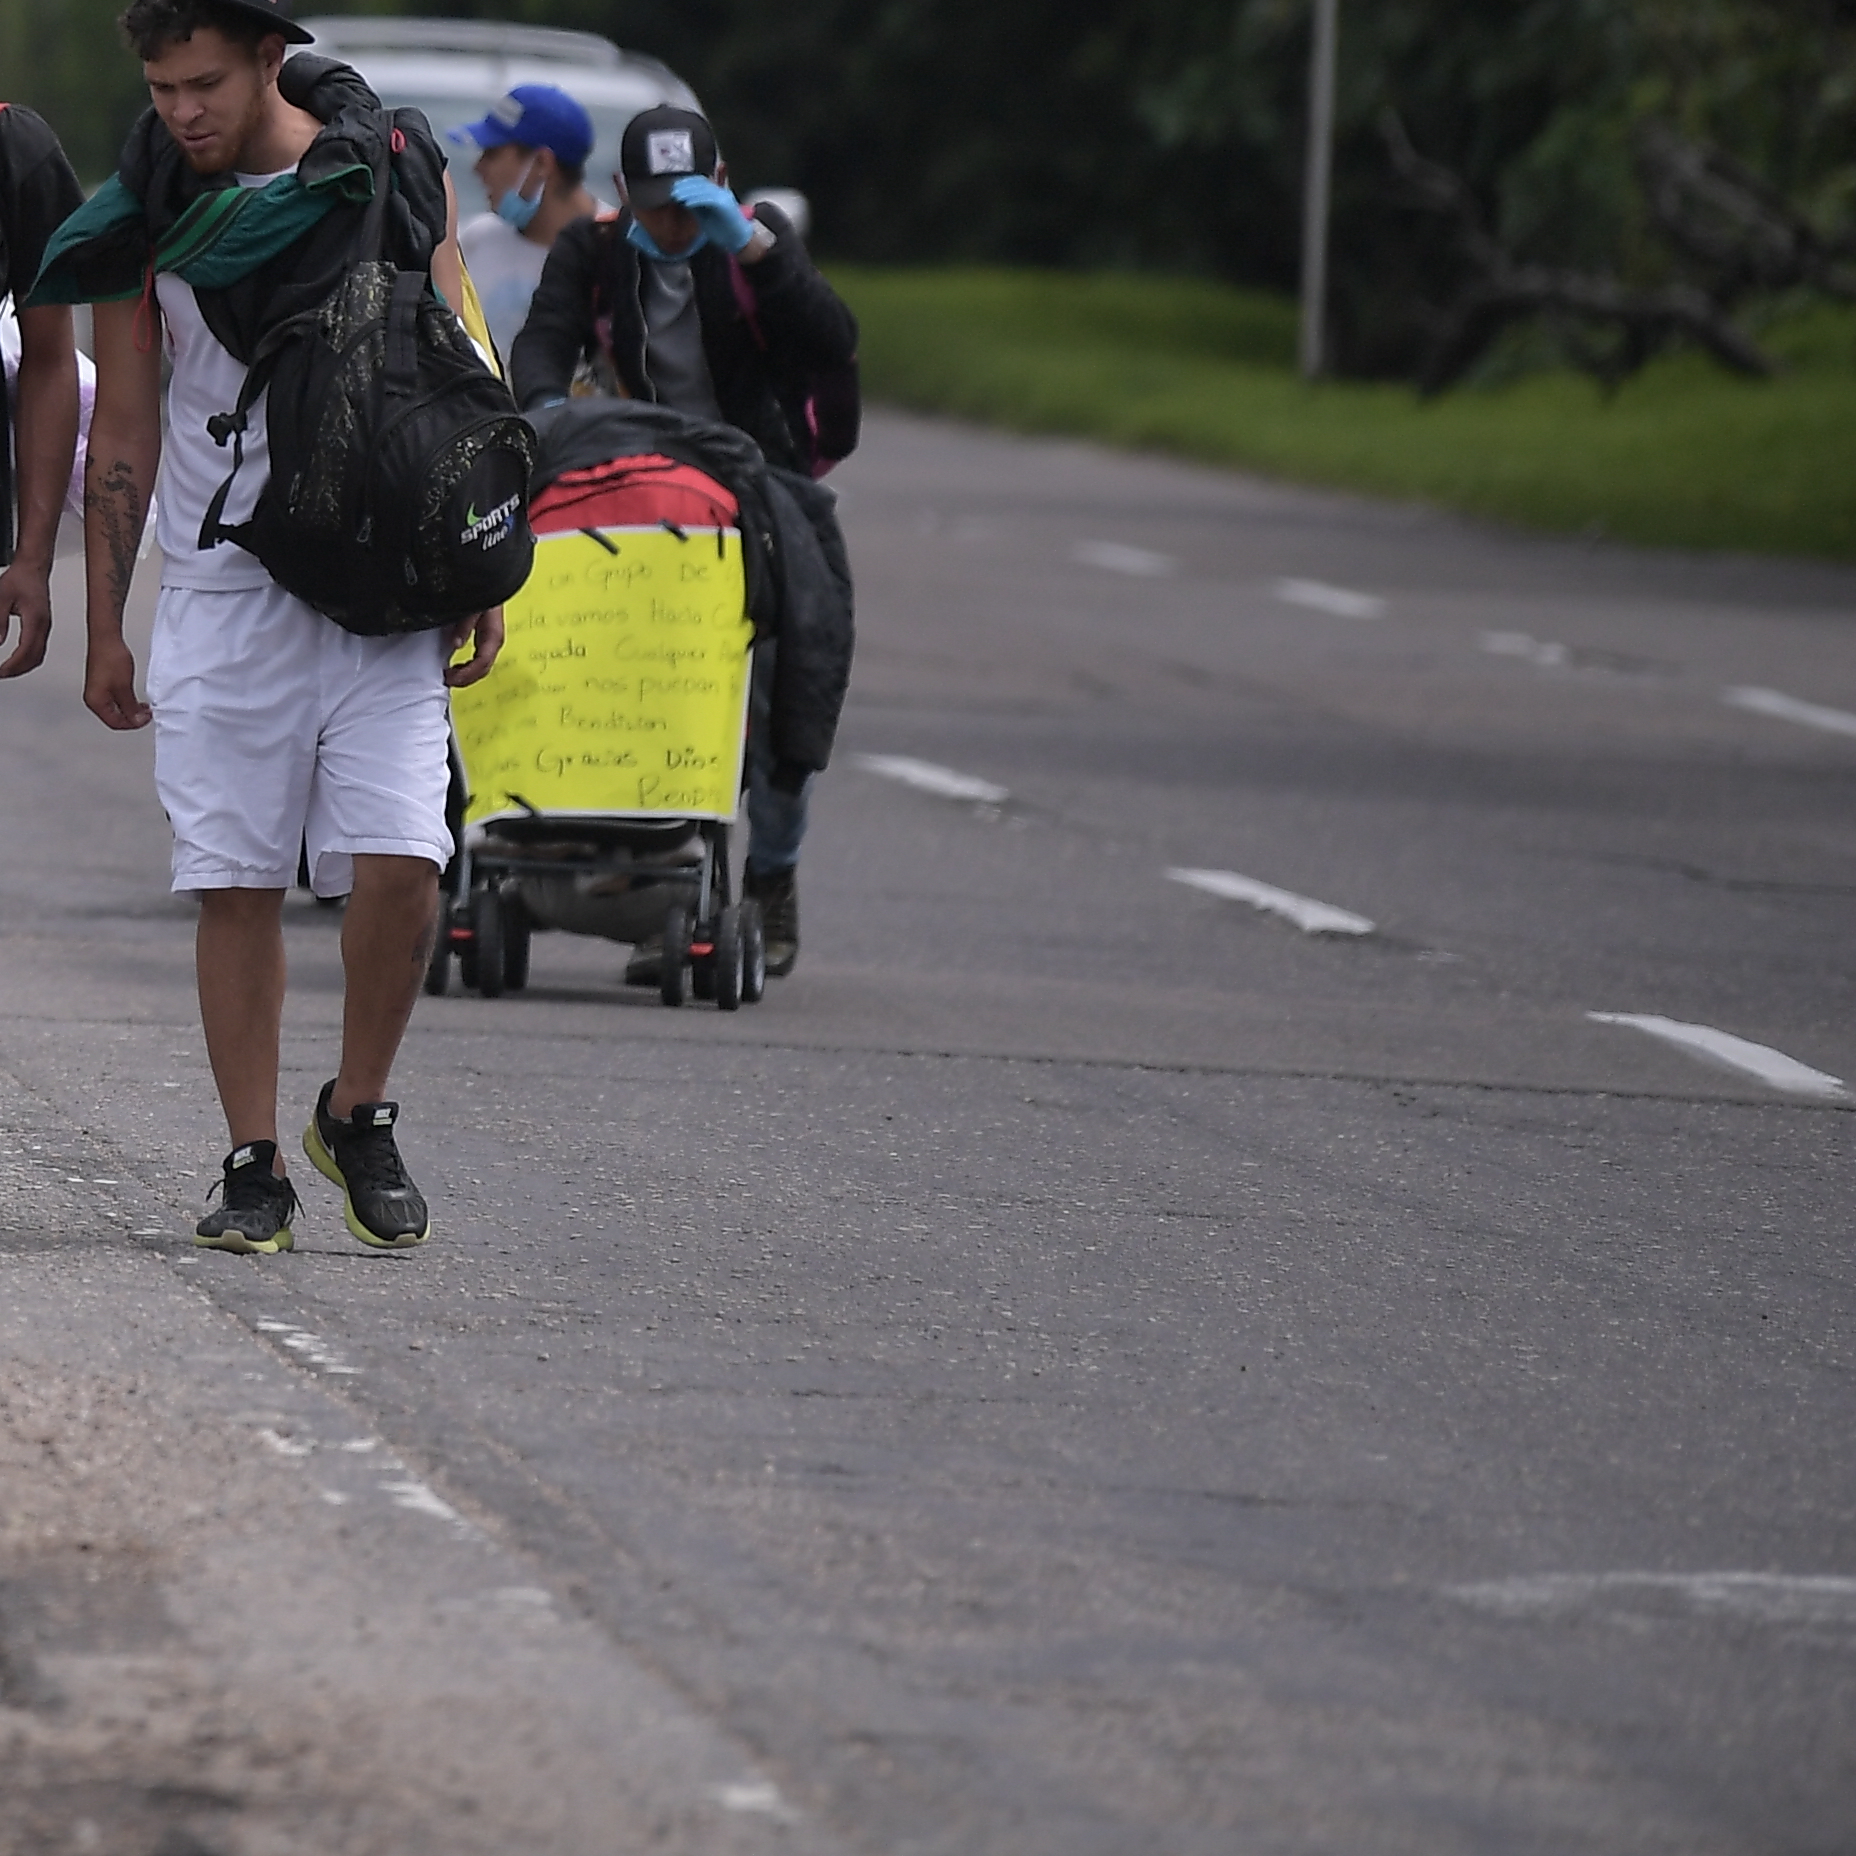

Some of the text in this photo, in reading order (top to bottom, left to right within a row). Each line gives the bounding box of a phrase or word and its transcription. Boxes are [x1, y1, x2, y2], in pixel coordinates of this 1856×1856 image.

[461, 493, 520, 544] SPORTS
[482, 525, 508, 551] line
[529, 638, 588, 673] ayuda
